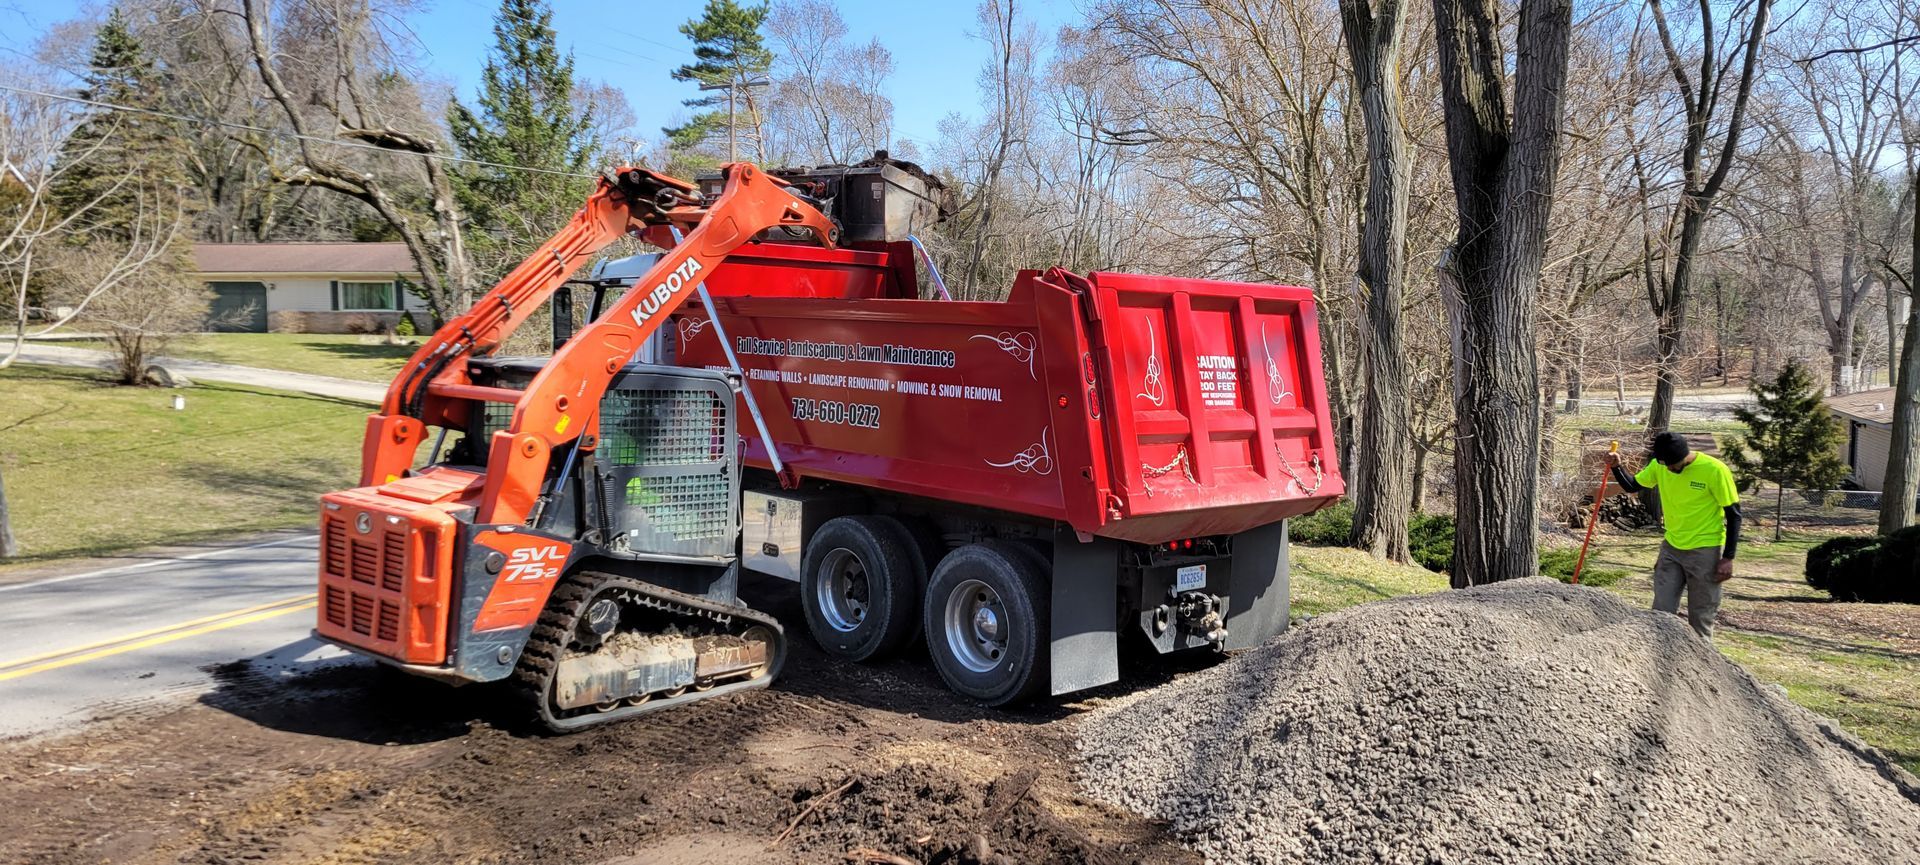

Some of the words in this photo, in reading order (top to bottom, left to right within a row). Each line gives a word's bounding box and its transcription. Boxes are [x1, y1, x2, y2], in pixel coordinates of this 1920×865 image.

[630, 256, 702, 327] KUBOTA
[737, 336, 753, 354] Full
[753, 337, 785, 356] Service
[786, 339, 846, 362] Landscaping
[847, 344, 856, 361] &
[856, 342, 881, 362] Lawn
[882, 344, 955, 368] Maintenance
[749, 368, 780, 382] RETAINING
[781, 371, 802, 384] WALLS
[809, 373, 846, 388] LANDSCAPE
[848, 376, 889, 391] RENOVATION
[897, 380, 929, 395] MOWING
[930, 383, 937, 396] &
[938, 384, 962, 398] SNOW
[964, 386, 1002, 402] REMOVAL
[1199, 371, 1214, 380] TAY
[1216, 371, 1237, 380] BACK
[1217, 381, 1236, 391] FEET
[792, 397, 880, 429] 734-660-0272
[509, 545, 566, 563] SVL
[504, 562, 558, 582] 75-2
